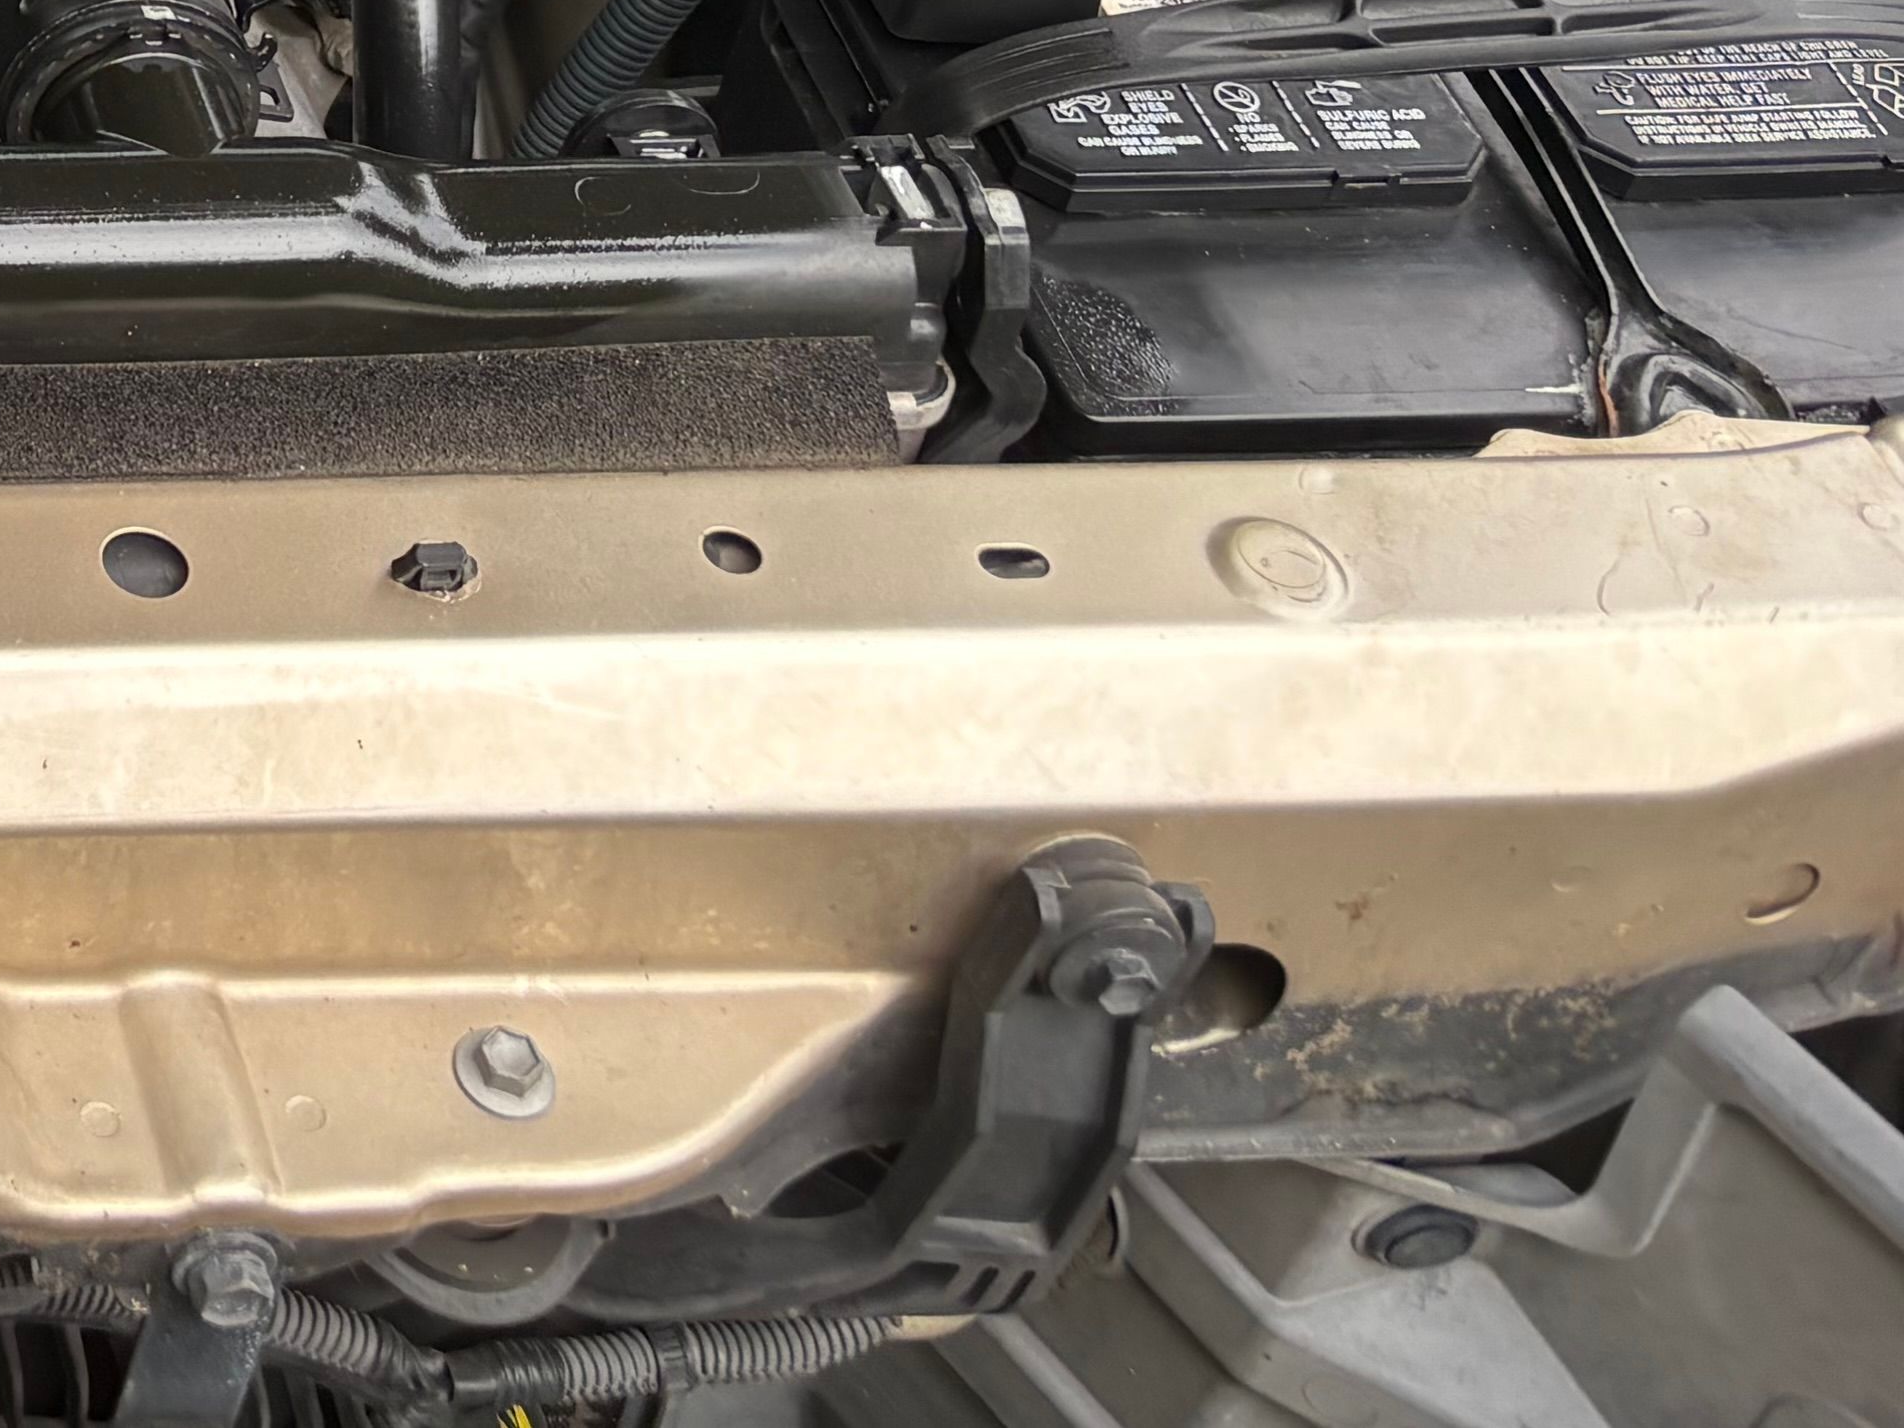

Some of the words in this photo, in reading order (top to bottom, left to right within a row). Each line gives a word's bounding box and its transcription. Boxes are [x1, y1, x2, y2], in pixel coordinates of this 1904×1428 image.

[1635, 71, 1683, 85] FLUSH
[1684, 70, 1721, 84] EYES
[1720, 67, 1813, 82] IMMEDIATELY
[1121, 90, 1175, 101] SHIELD
[1646, 85, 1680, 98] WITH
[1740, 82, 1769, 95] GET
[1655, 96, 1718, 110] MEDICAL
[1719, 94, 1756, 108] HELP
[1755, 92, 1794, 106] FAST
[1101, 112, 1184, 124] EXPLOSIVE
[1236, 112, 1261, 123] NO
[1317, 110, 1390, 121] SULFURIC
[1392, 108, 1426, 120] ACID
